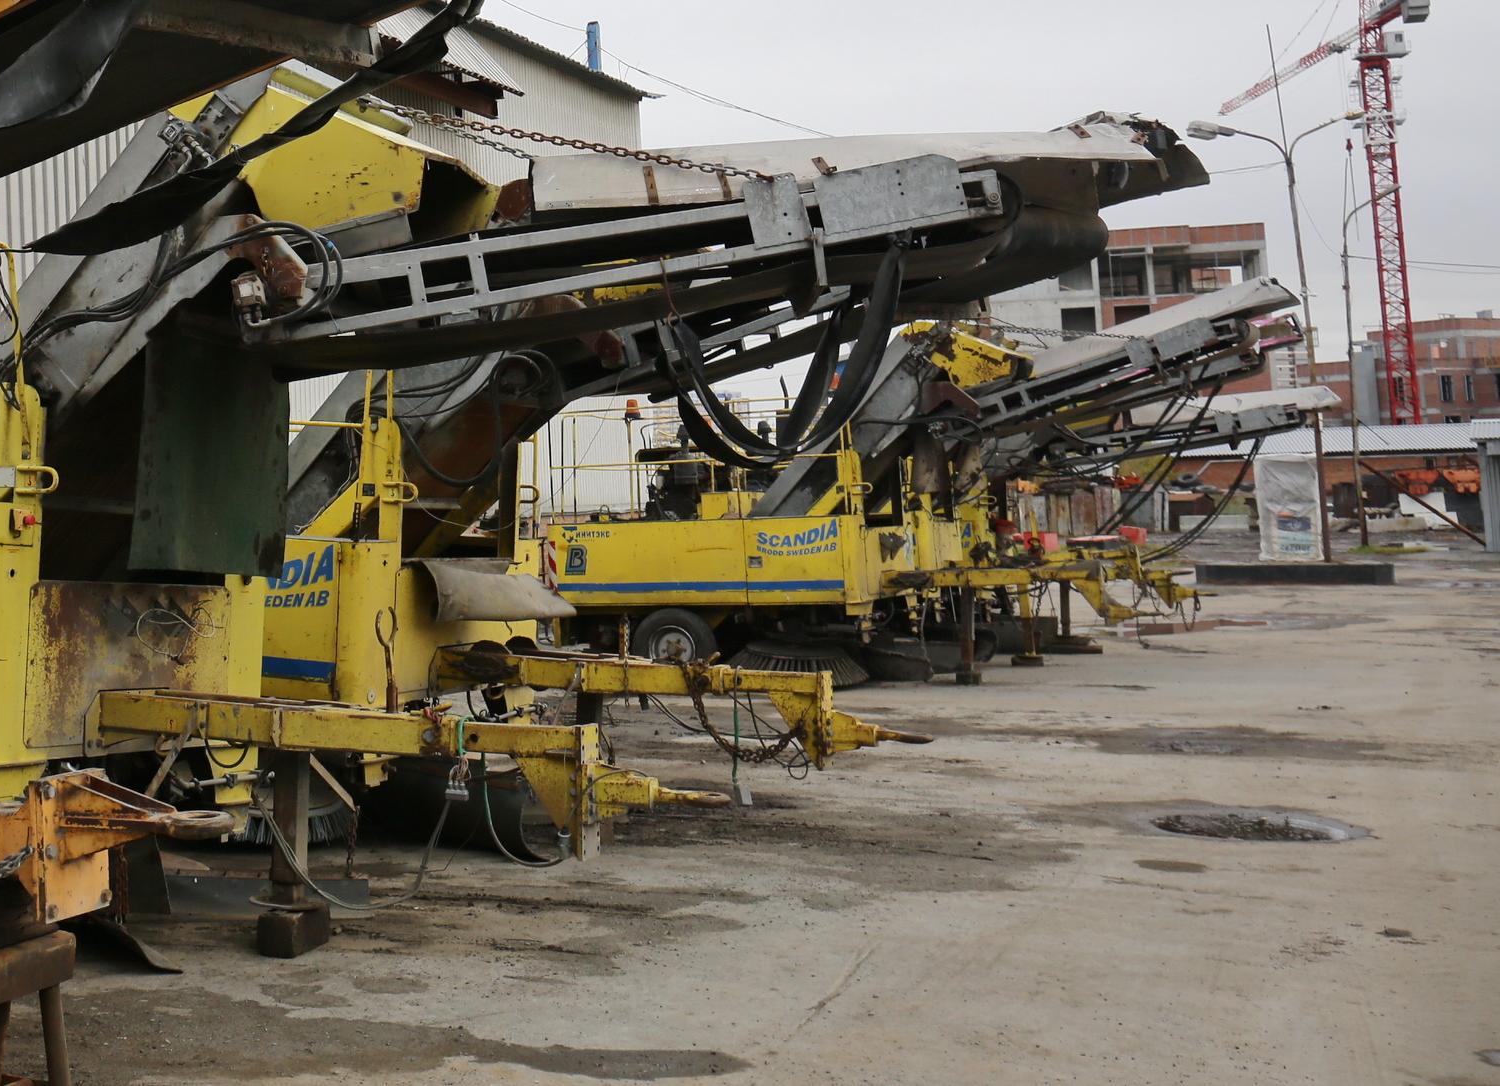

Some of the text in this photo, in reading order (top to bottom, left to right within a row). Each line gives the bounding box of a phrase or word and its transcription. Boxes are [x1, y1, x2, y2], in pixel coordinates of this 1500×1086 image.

[757, 518, 838, 547] SCANDIA
[786, 545, 823, 556] SWEDEN
[823, 542, 837, 552] AB
[264, 590, 330, 608] EDEN AB
